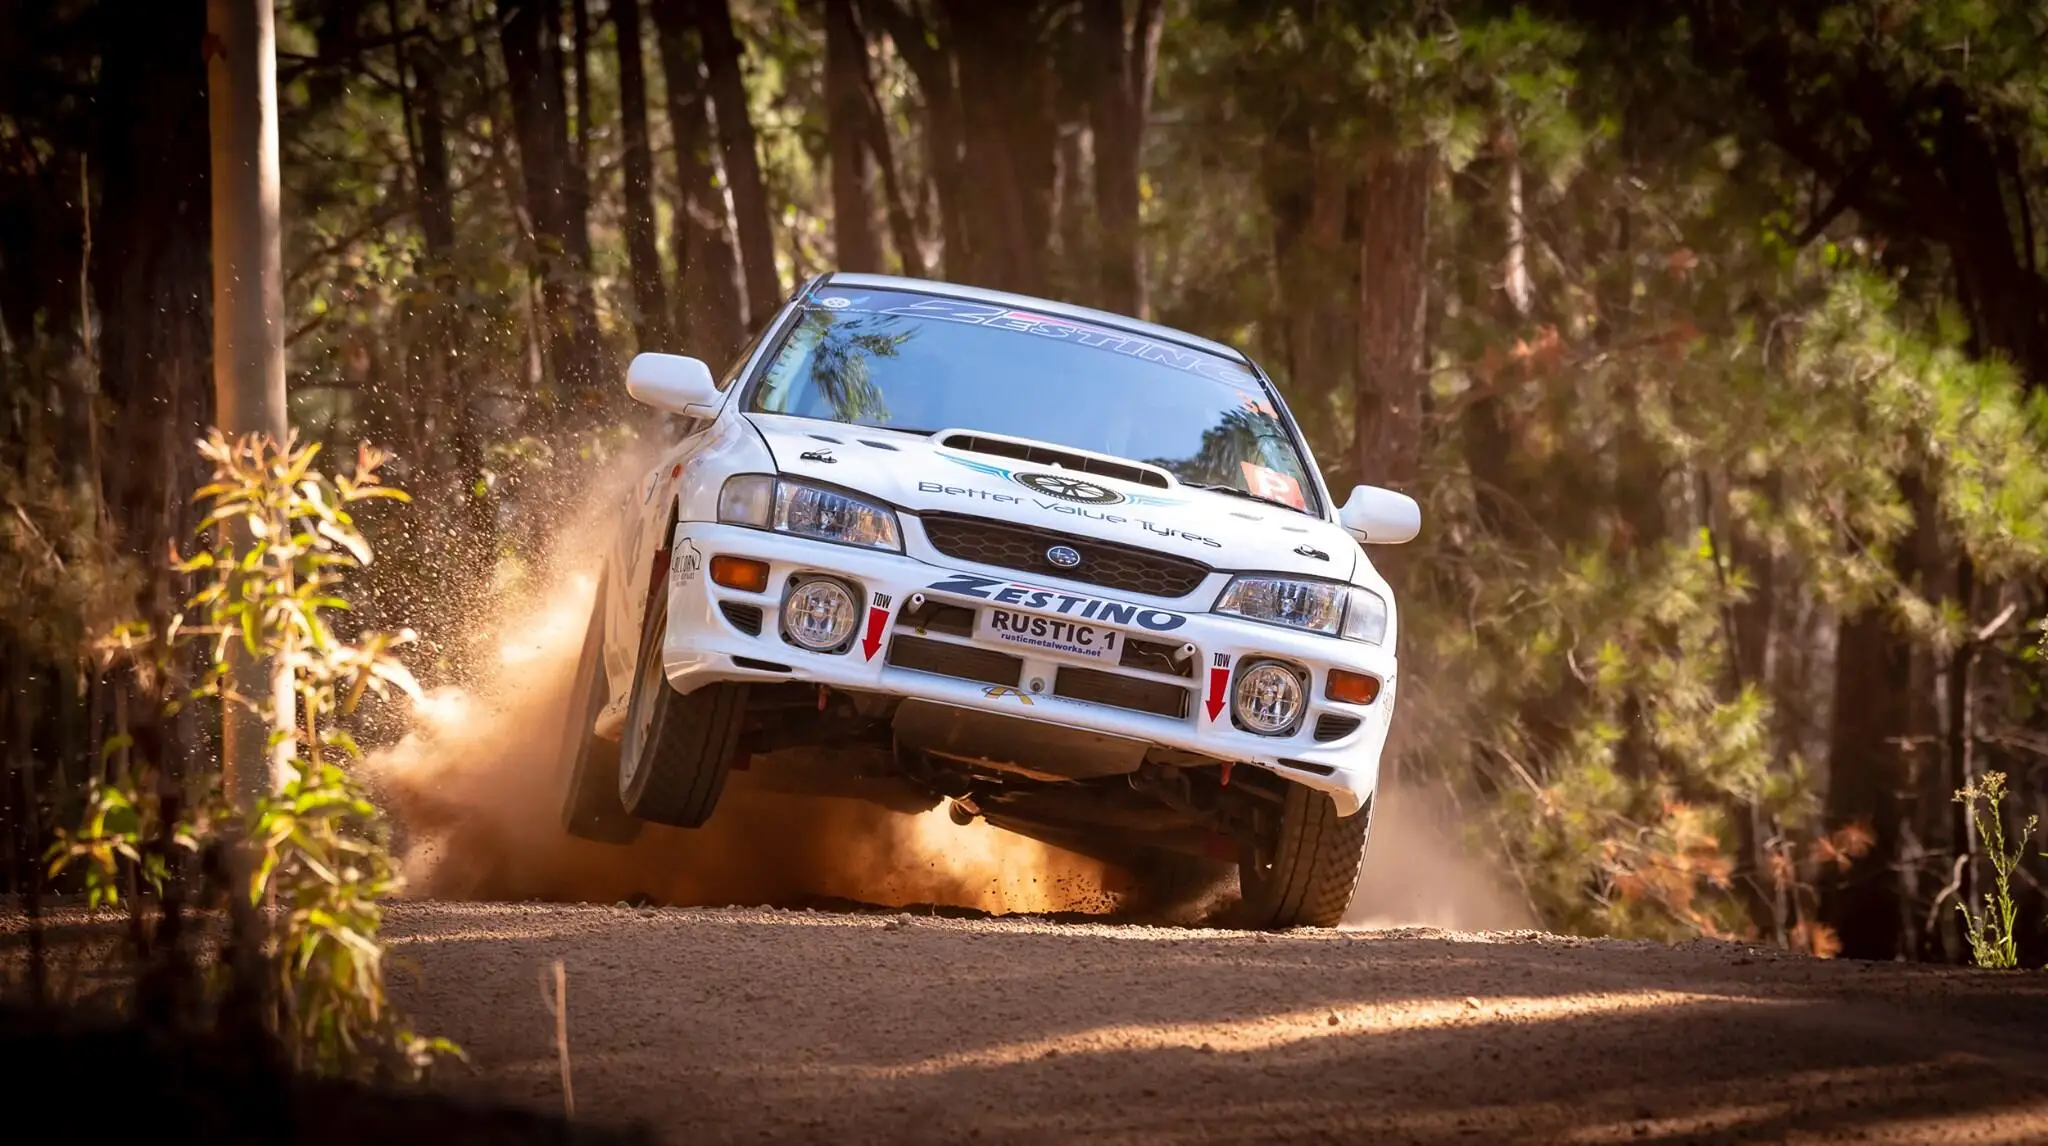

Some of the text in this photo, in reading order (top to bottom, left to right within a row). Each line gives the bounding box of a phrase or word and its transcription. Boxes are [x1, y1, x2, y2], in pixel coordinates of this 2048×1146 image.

[878, 299, 1254, 390] ZESTINO
[918, 481, 1223, 548] Better Value Tyres
[873, 591, 892, 609] TOW
[926, 574, 1187, 632] ZESTINO
[991, 610, 1117, 651] RUSTIC 1
[1000, 632, 1102, 658] rusticmetalworks.net
[1213, 652, 1231, 668] TOW
